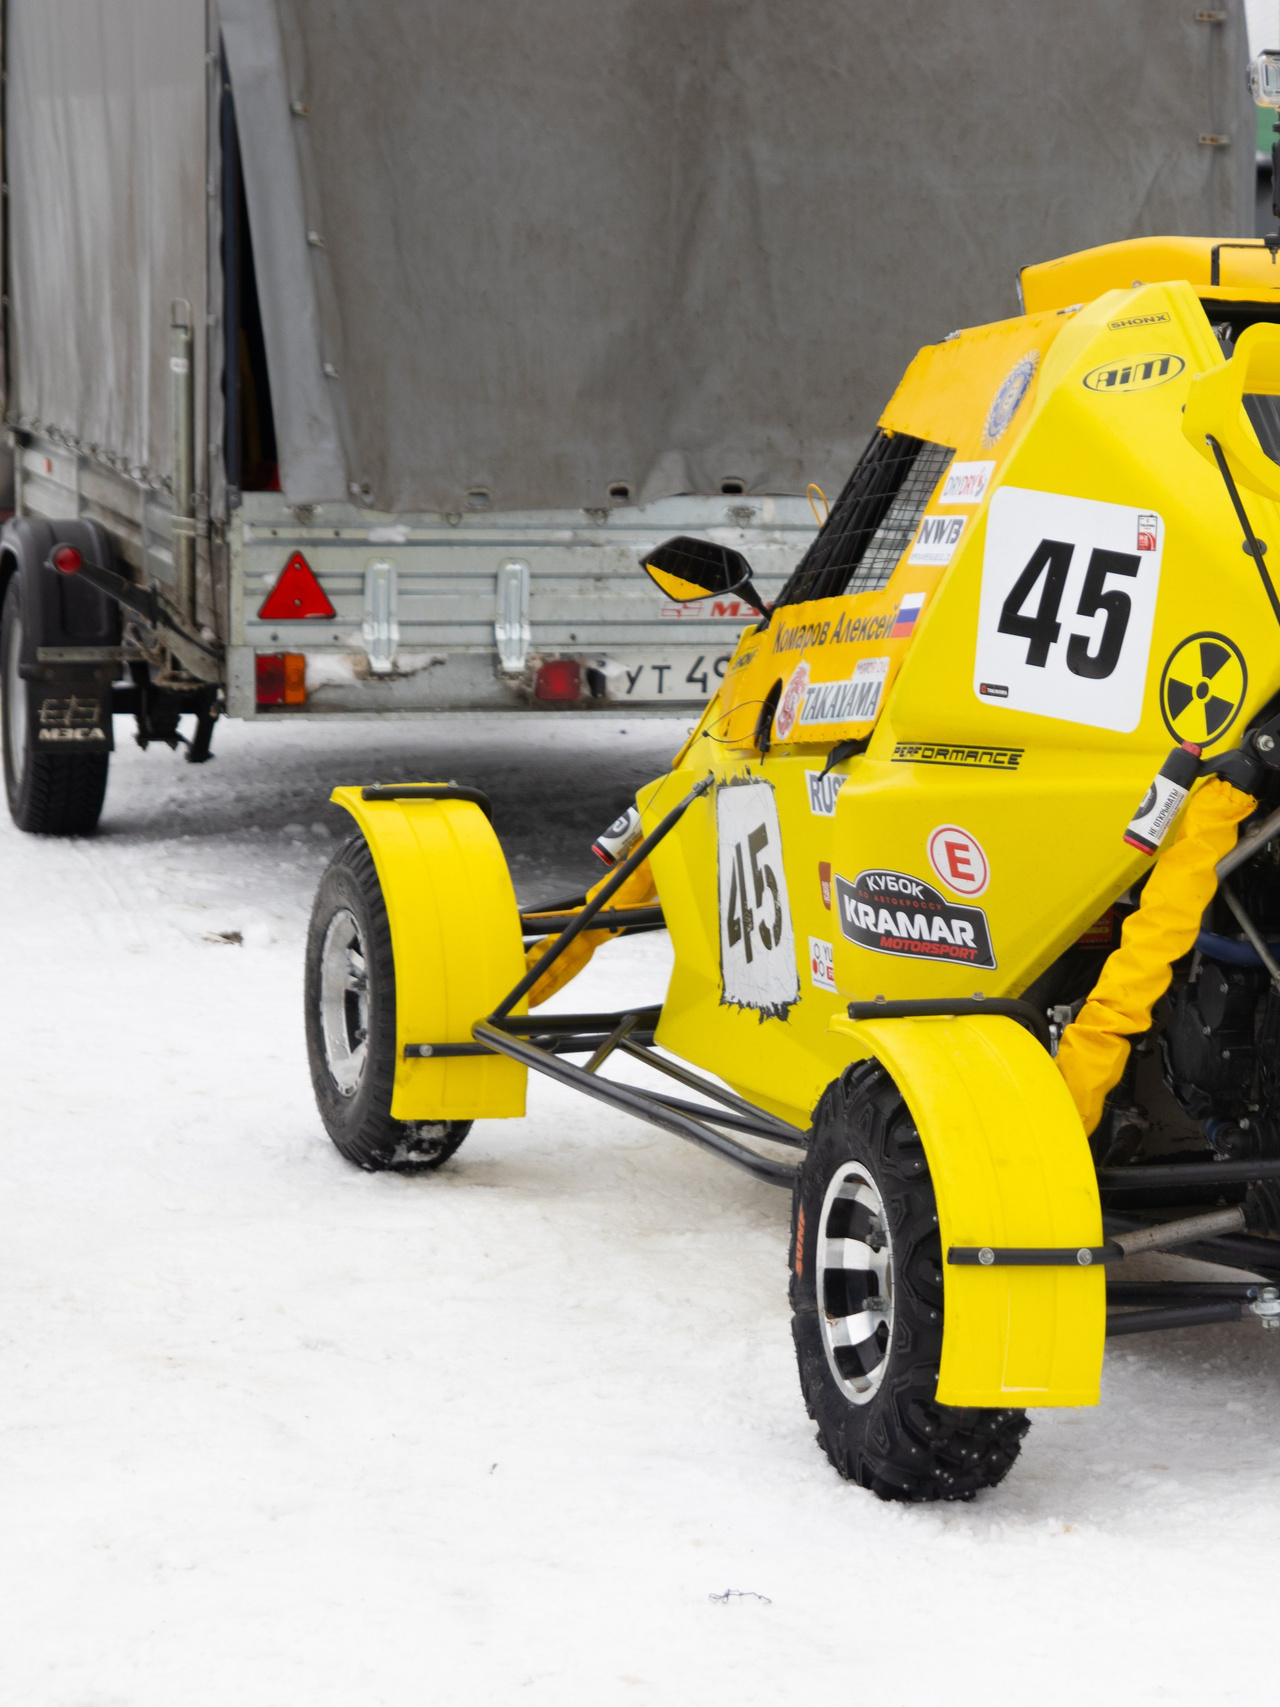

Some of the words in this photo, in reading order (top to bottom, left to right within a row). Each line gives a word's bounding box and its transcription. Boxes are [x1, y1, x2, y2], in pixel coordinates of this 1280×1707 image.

[1111, 314, 1167, 329] SHONX
[916, 518, 965, 544] NWB
[997, 538, 1142, 680] 45
[772, 621, 831, 656] Комаров
[830, 604, 900, 644] Алексей
[801, 681, 883, 720] TAKAYAMA
[892, 746, 1022, 765] PERFORMANCE
[944, 840, 976, 882] E
[727, 822, 782, 964] 45
[866, 876, 925, 900] КУБОК
[843, 894, 978, 948] KRAMAR
[880, 936, 979, 960] MOTORSPORT
